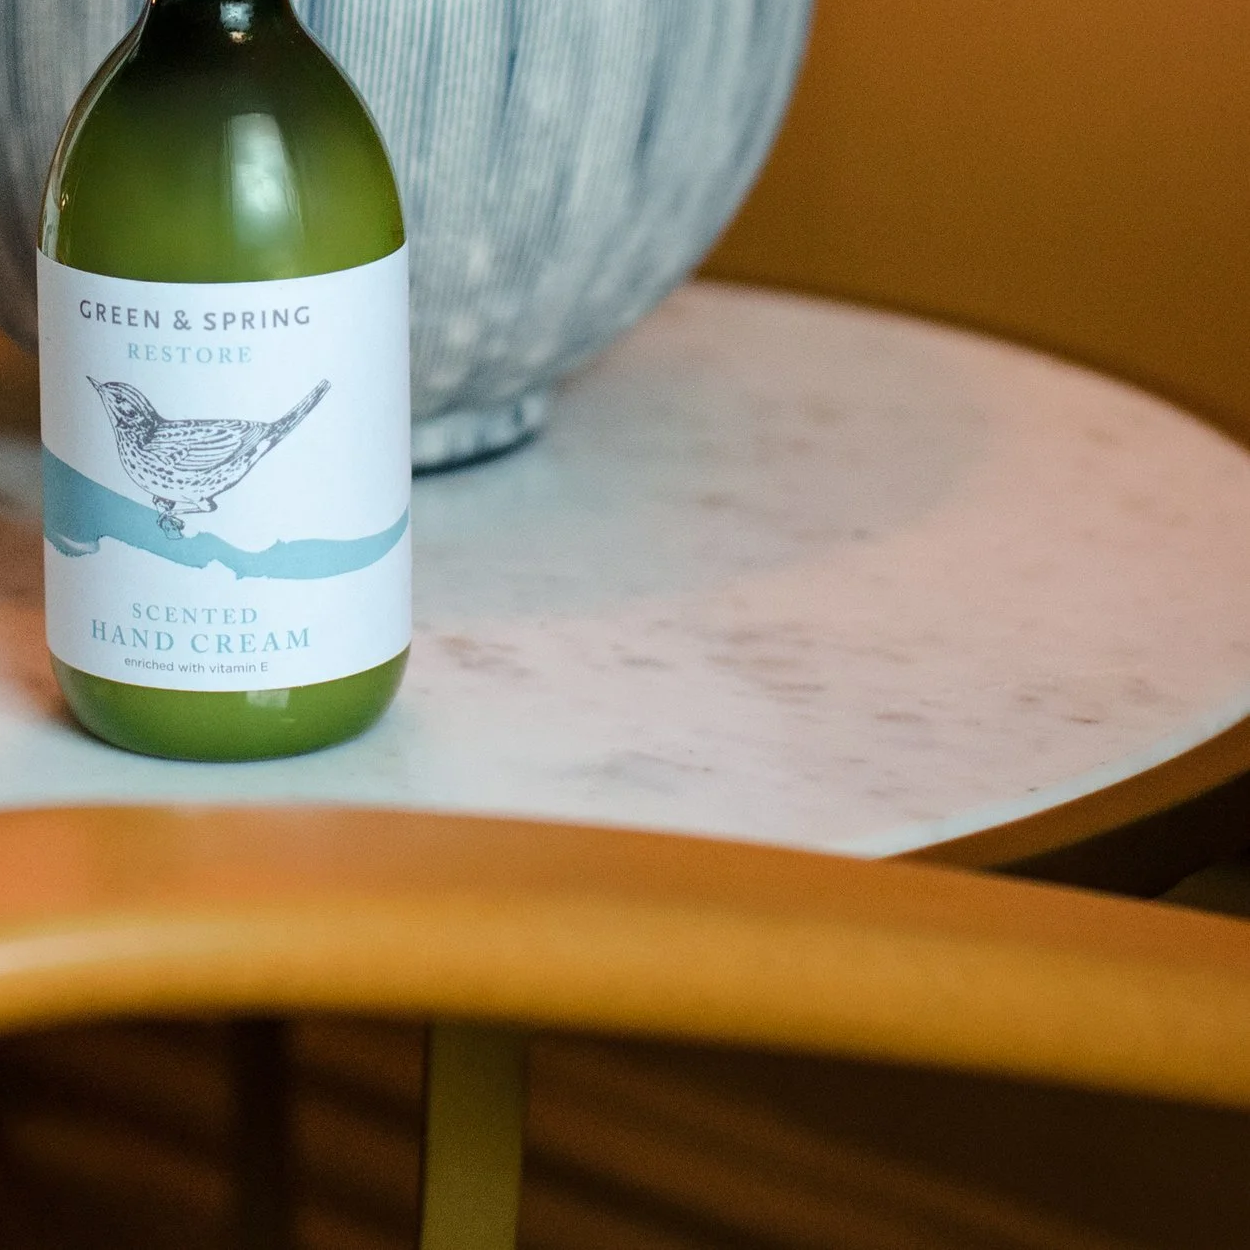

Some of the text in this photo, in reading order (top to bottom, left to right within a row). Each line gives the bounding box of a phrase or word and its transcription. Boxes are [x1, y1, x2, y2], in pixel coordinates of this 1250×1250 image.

[79, 299, 311, 331] GREEN & SPRING
[127, 342, 252, 364] RESTORE
[132, 602, 257, 625] SCENTED
[91, 618, 311, 654] HAND CREAM
[124, 657, 269, 674] enriched with vitamin E
